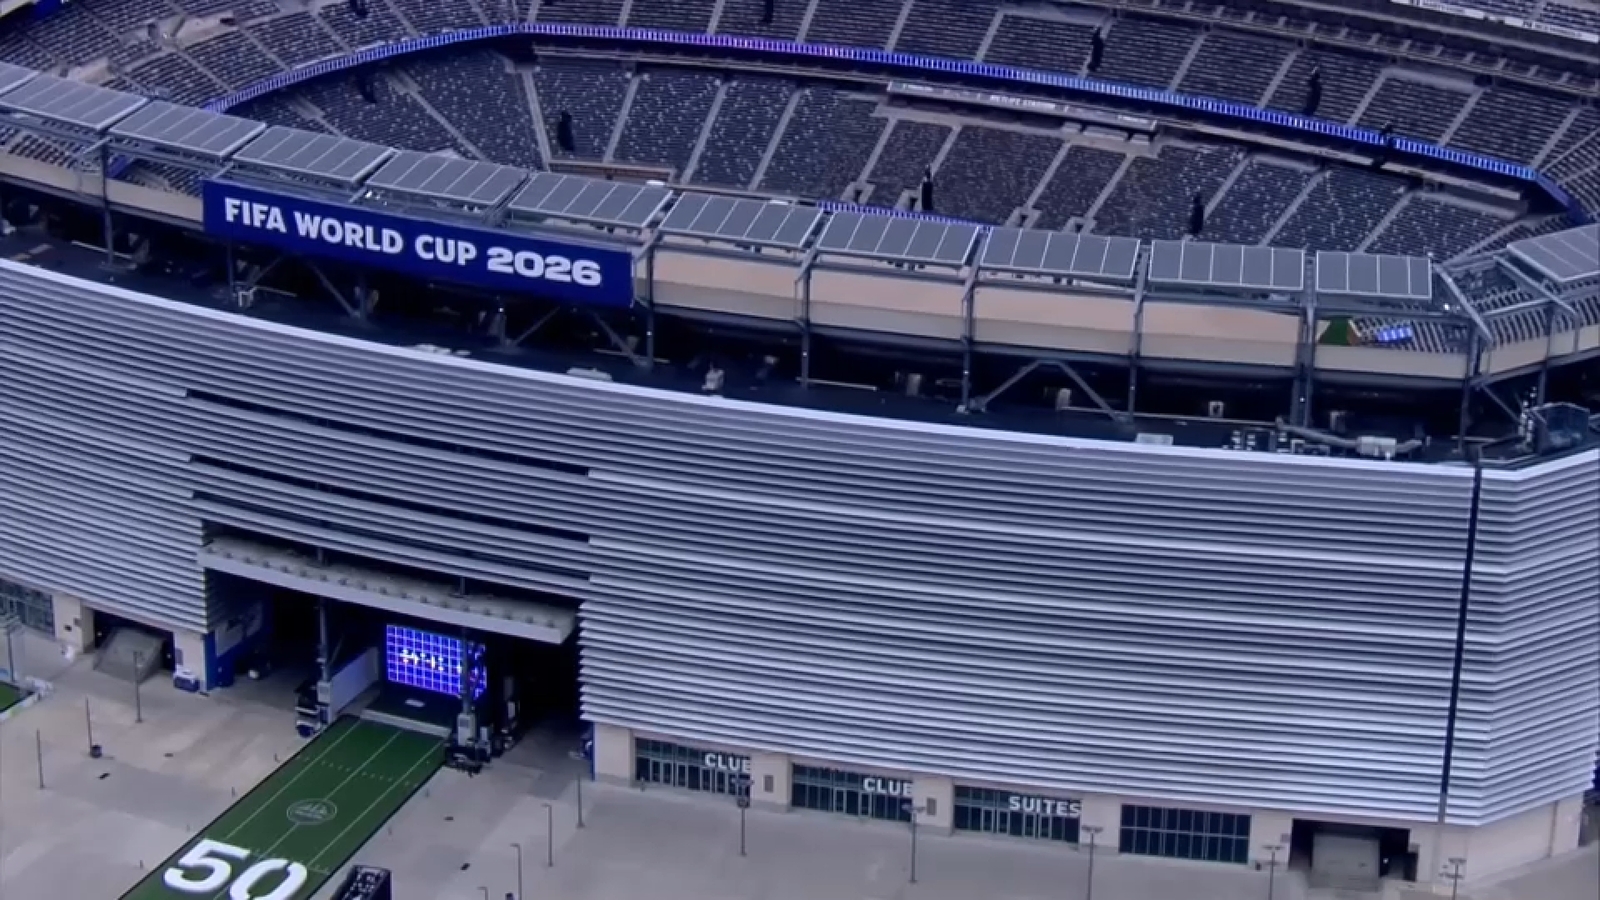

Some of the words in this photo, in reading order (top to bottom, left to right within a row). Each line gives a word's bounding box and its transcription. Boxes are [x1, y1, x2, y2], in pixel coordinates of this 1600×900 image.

[225, 198, 287, 233] FIFA
[294, 211, 404, 254] WORLD
[414, 234, 478, 266] CUP
[486, 247, 602, 286] 2026
[1009, 796, 1082, 817] SUITES
[164, 838, 308, 900] 50
